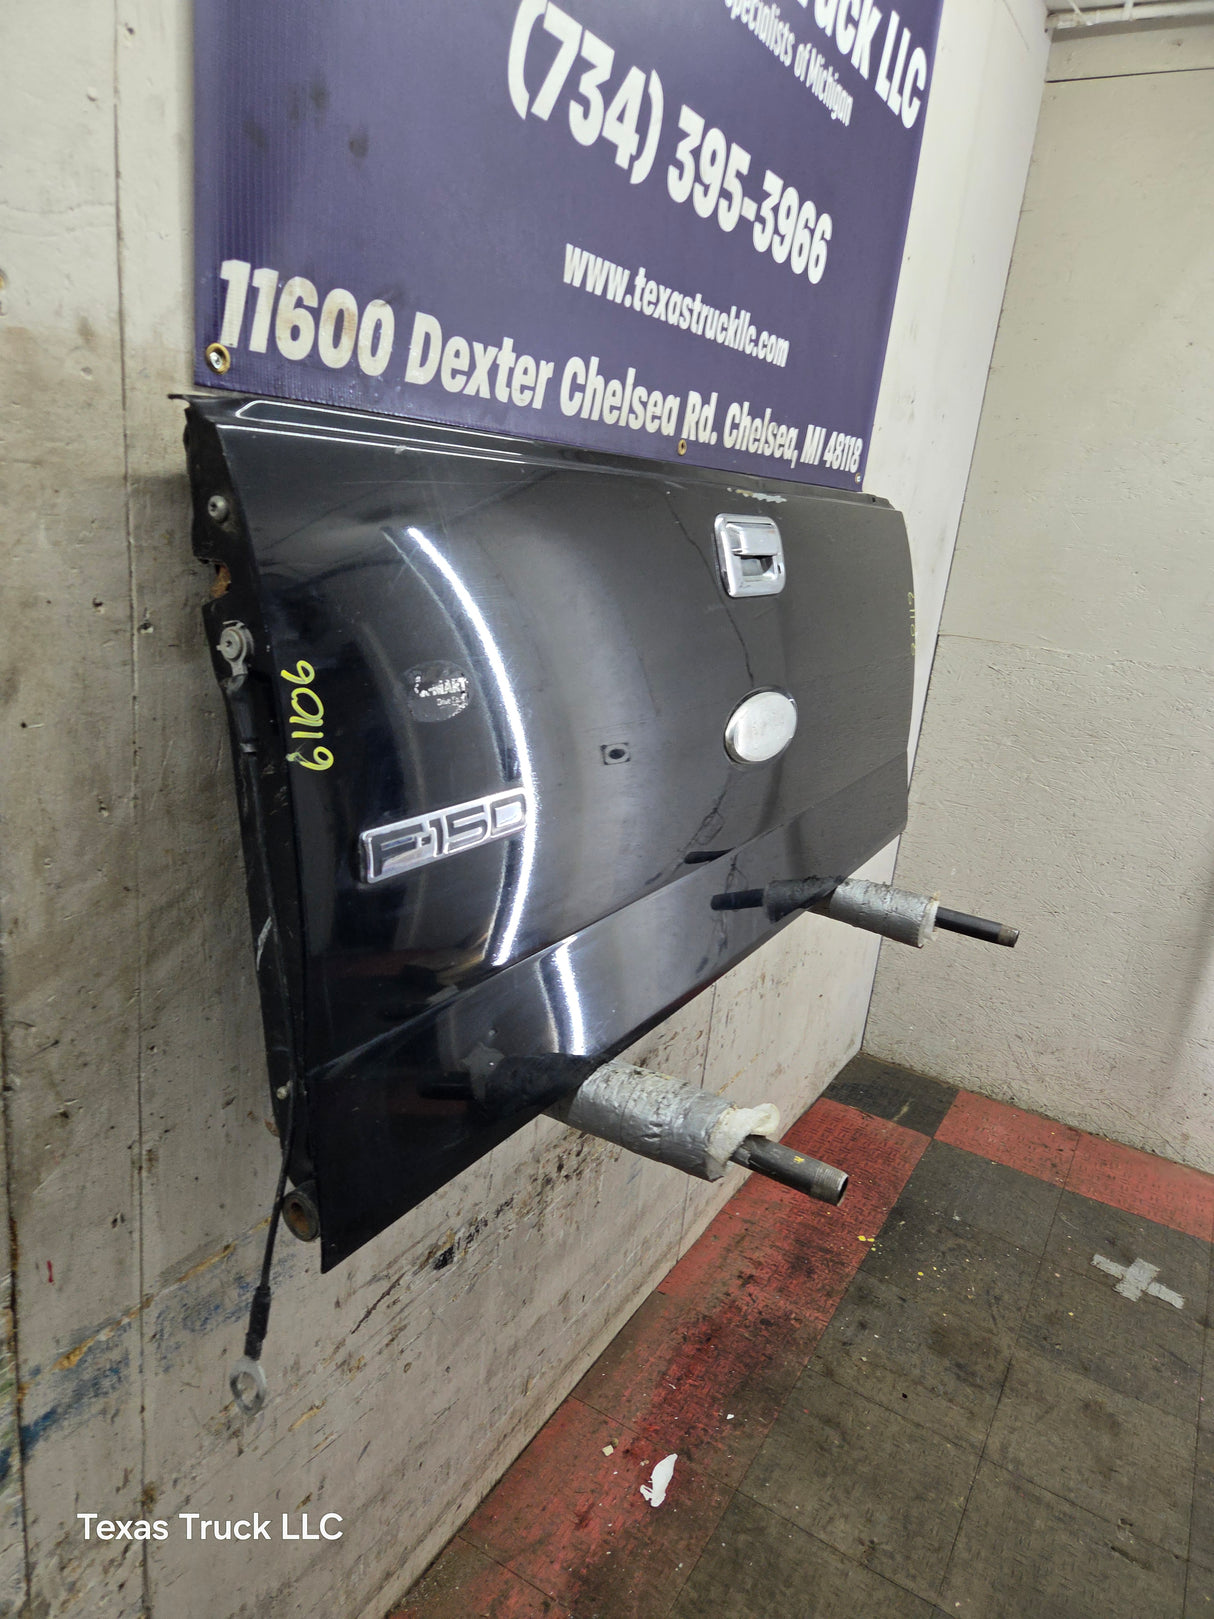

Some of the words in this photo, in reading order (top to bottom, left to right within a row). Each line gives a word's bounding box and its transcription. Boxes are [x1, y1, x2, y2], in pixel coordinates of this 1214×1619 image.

[793, 43, 812, 82] of
[806, 47, 853, 126] Michigan
[874, 10, 927, 129] LLC
[508, 0, 664, 184] (734)
[667, 104, 832, 284] 395-3966
[563, 243, 790, 367] www.texastruckllc.com
[219, 259, 395, 376] 11600
[405, 311, 554, 410] Dexter
[560, 356, 680, 436] Chelsea
[681, 390, 718, 445] Rd.
[723, 401, 798, 468] Chelsea,
[800, 424, 826, 465] MI
[823, 431, 863, 473] 48118
[281, 660, 334, 771] 61106
[366, 786, 528, 883] F-150
